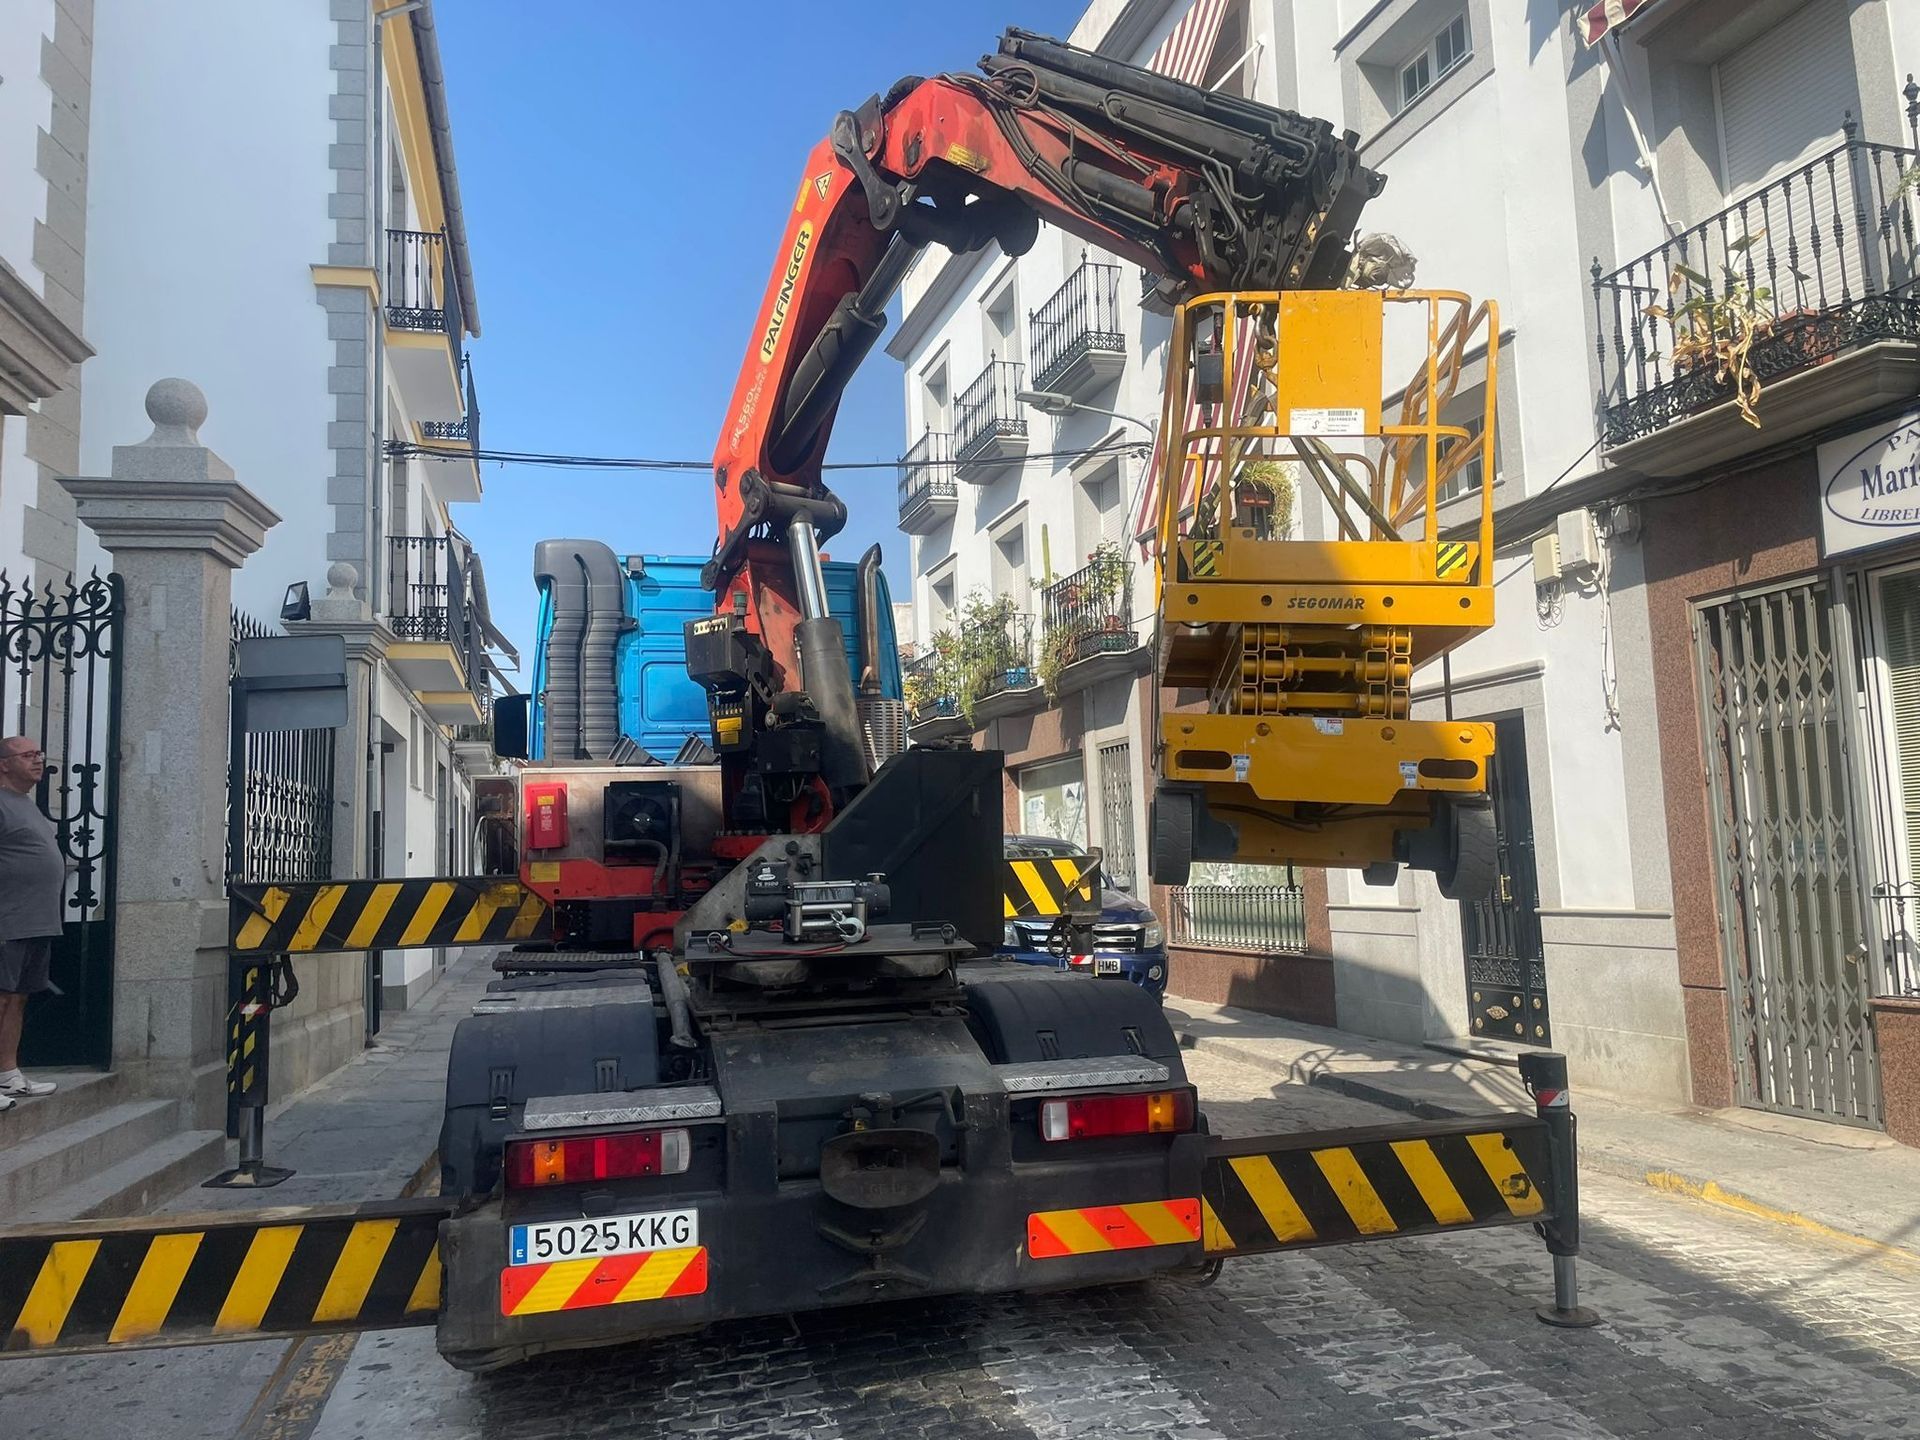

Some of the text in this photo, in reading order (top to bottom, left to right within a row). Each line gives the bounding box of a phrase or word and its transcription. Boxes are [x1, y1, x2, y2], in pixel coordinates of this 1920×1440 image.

[762, 230, 810, 355] PALFINGER
[1860, 452, 1920, 501] Marí
[1287, 597, 1365, 610] SEGOMAR
[1097, 960, 1118, 971] HMB
